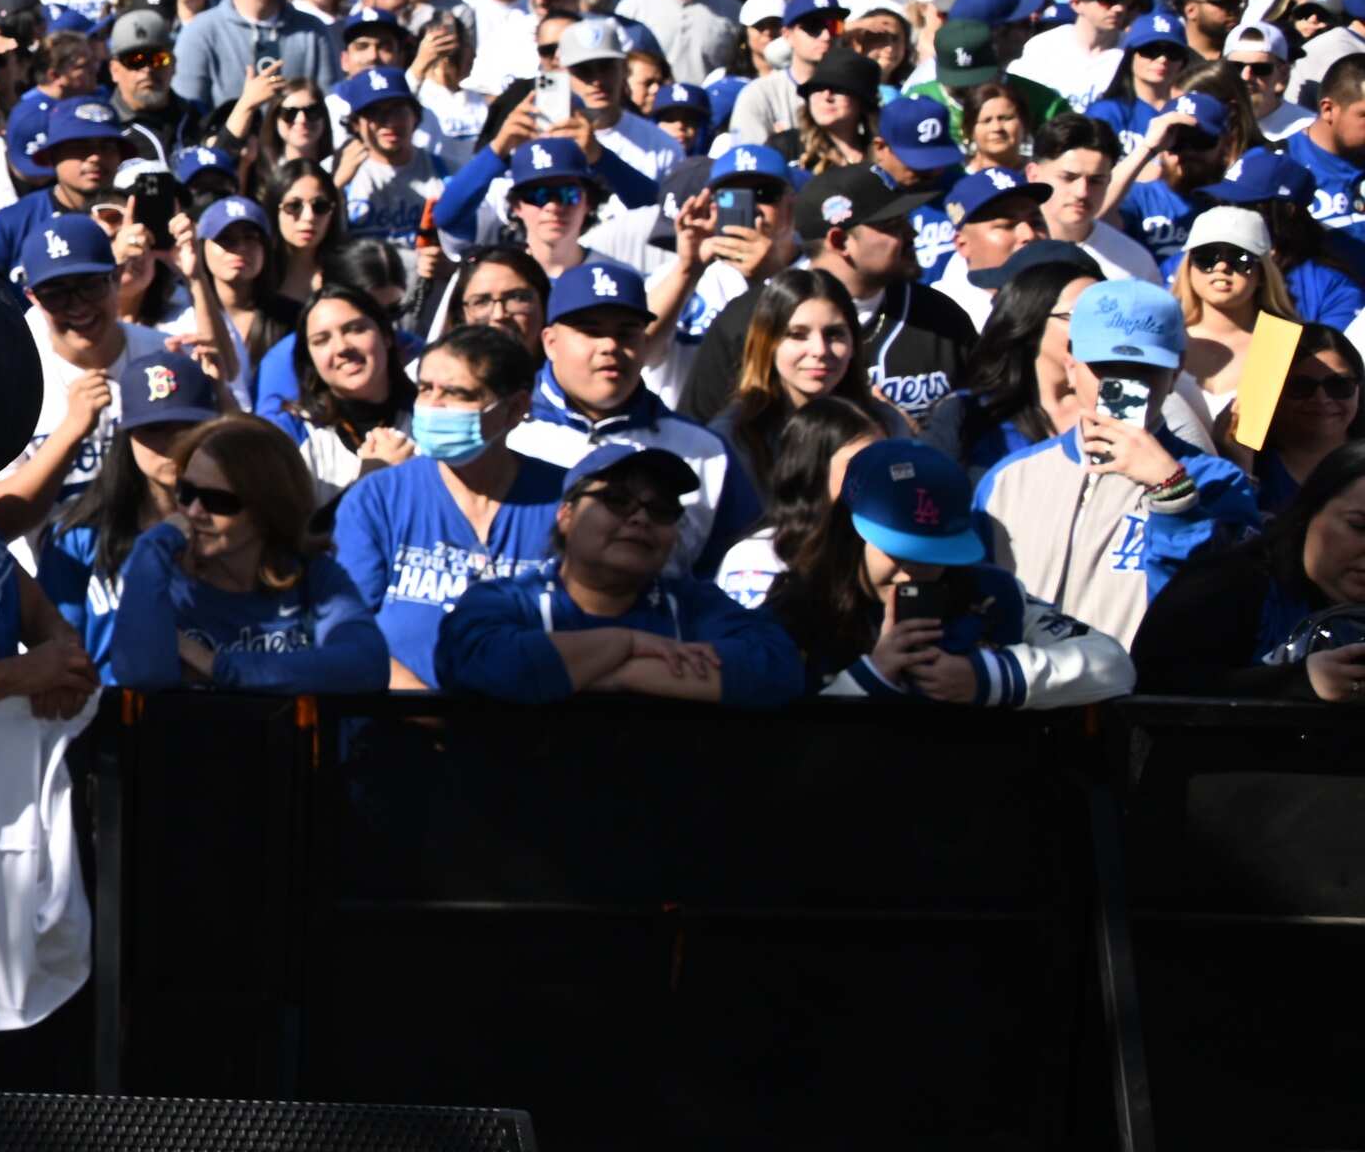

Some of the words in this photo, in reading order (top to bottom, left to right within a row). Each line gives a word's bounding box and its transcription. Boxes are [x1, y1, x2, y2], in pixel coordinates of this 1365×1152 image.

[531, 144, 553, 170] LA
[43, 229, 71, 259] LA
[591, 266, 618, 297] LA
[914, 487, 940, 525] LA
